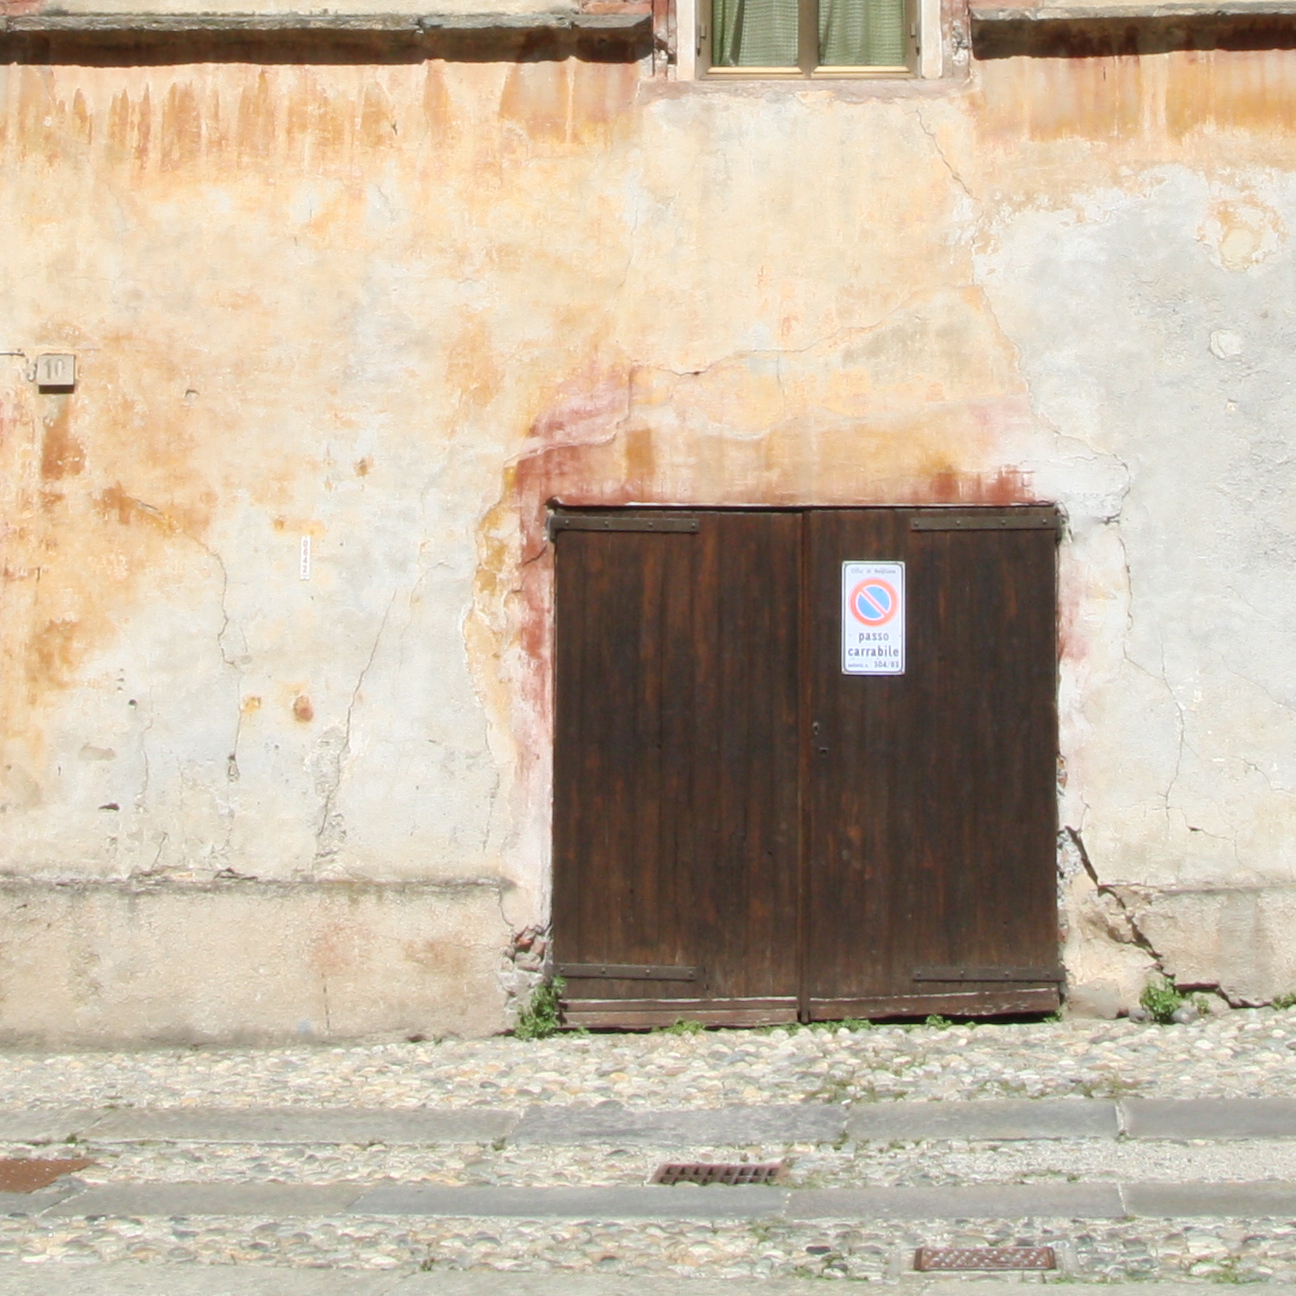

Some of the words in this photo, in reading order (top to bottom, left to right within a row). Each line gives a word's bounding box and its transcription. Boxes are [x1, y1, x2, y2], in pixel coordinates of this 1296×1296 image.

[44, 358, 65, 381] 10
[859, 632, 890, 644] passo
[848, 644, 900, 658] carrabile
